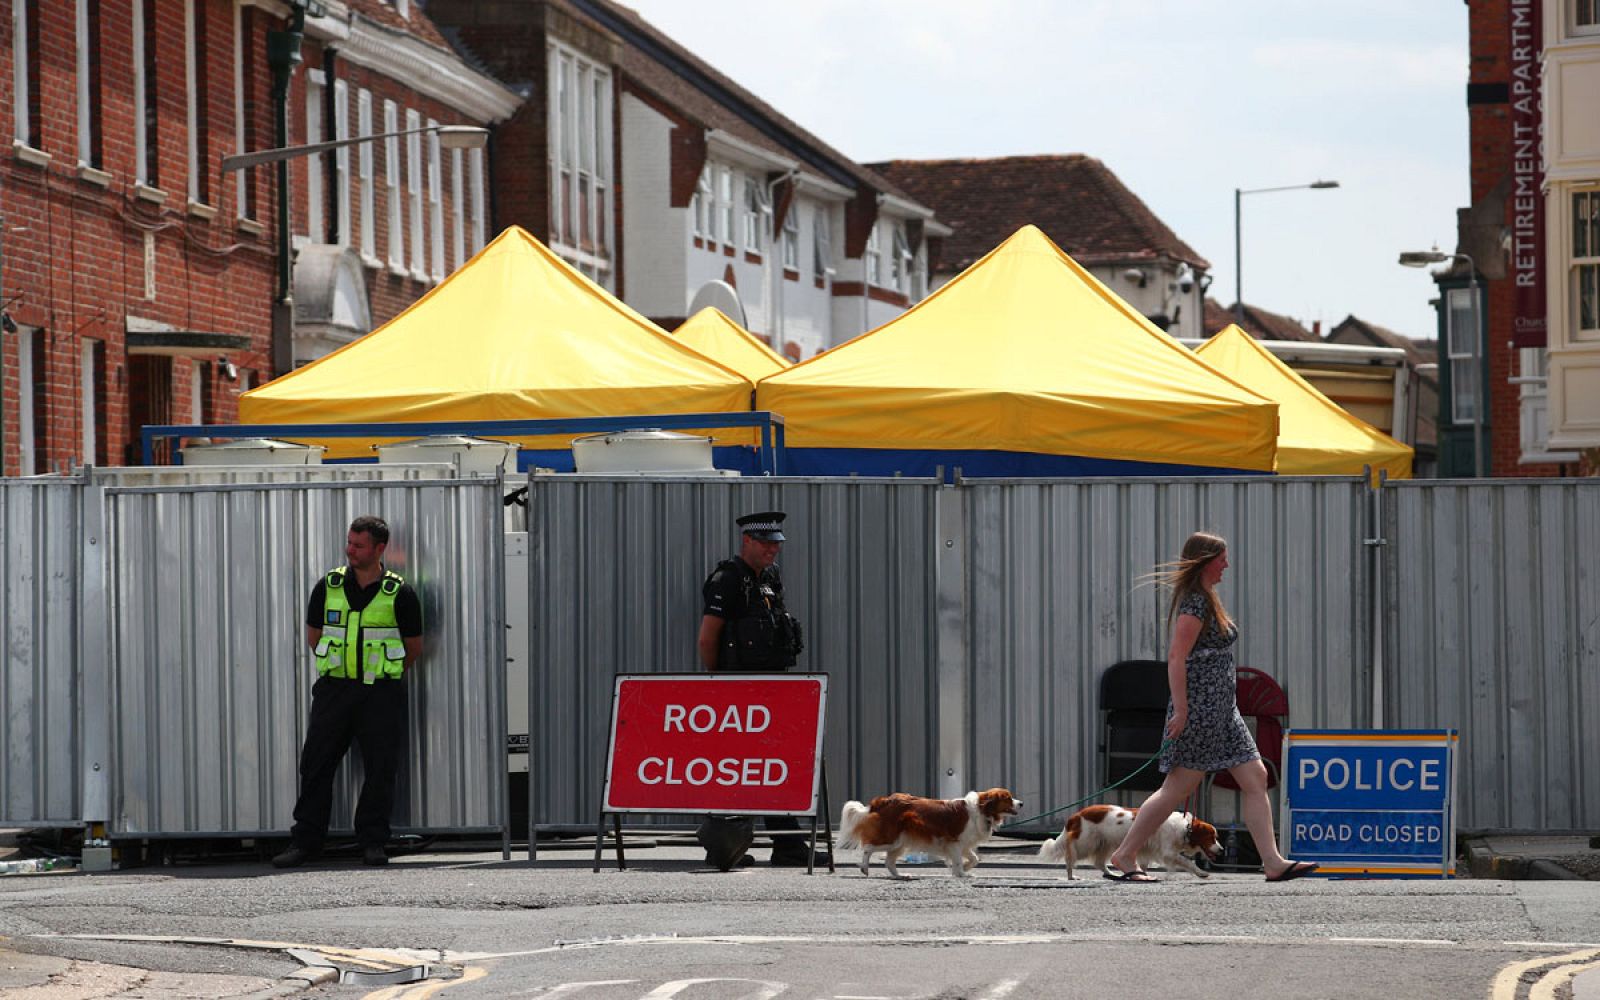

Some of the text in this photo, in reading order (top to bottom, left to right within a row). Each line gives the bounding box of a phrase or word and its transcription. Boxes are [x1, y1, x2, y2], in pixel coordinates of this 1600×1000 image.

[1514, 121, 1535, 286] RETIREMENT
[663, 704, 771, 733] ROAD
[637, 757, 788, 786] CLOSED
[1299, 758, 1440, 791] POLICE
[1295, 823, 1441, 843] ROAD CLOSED
